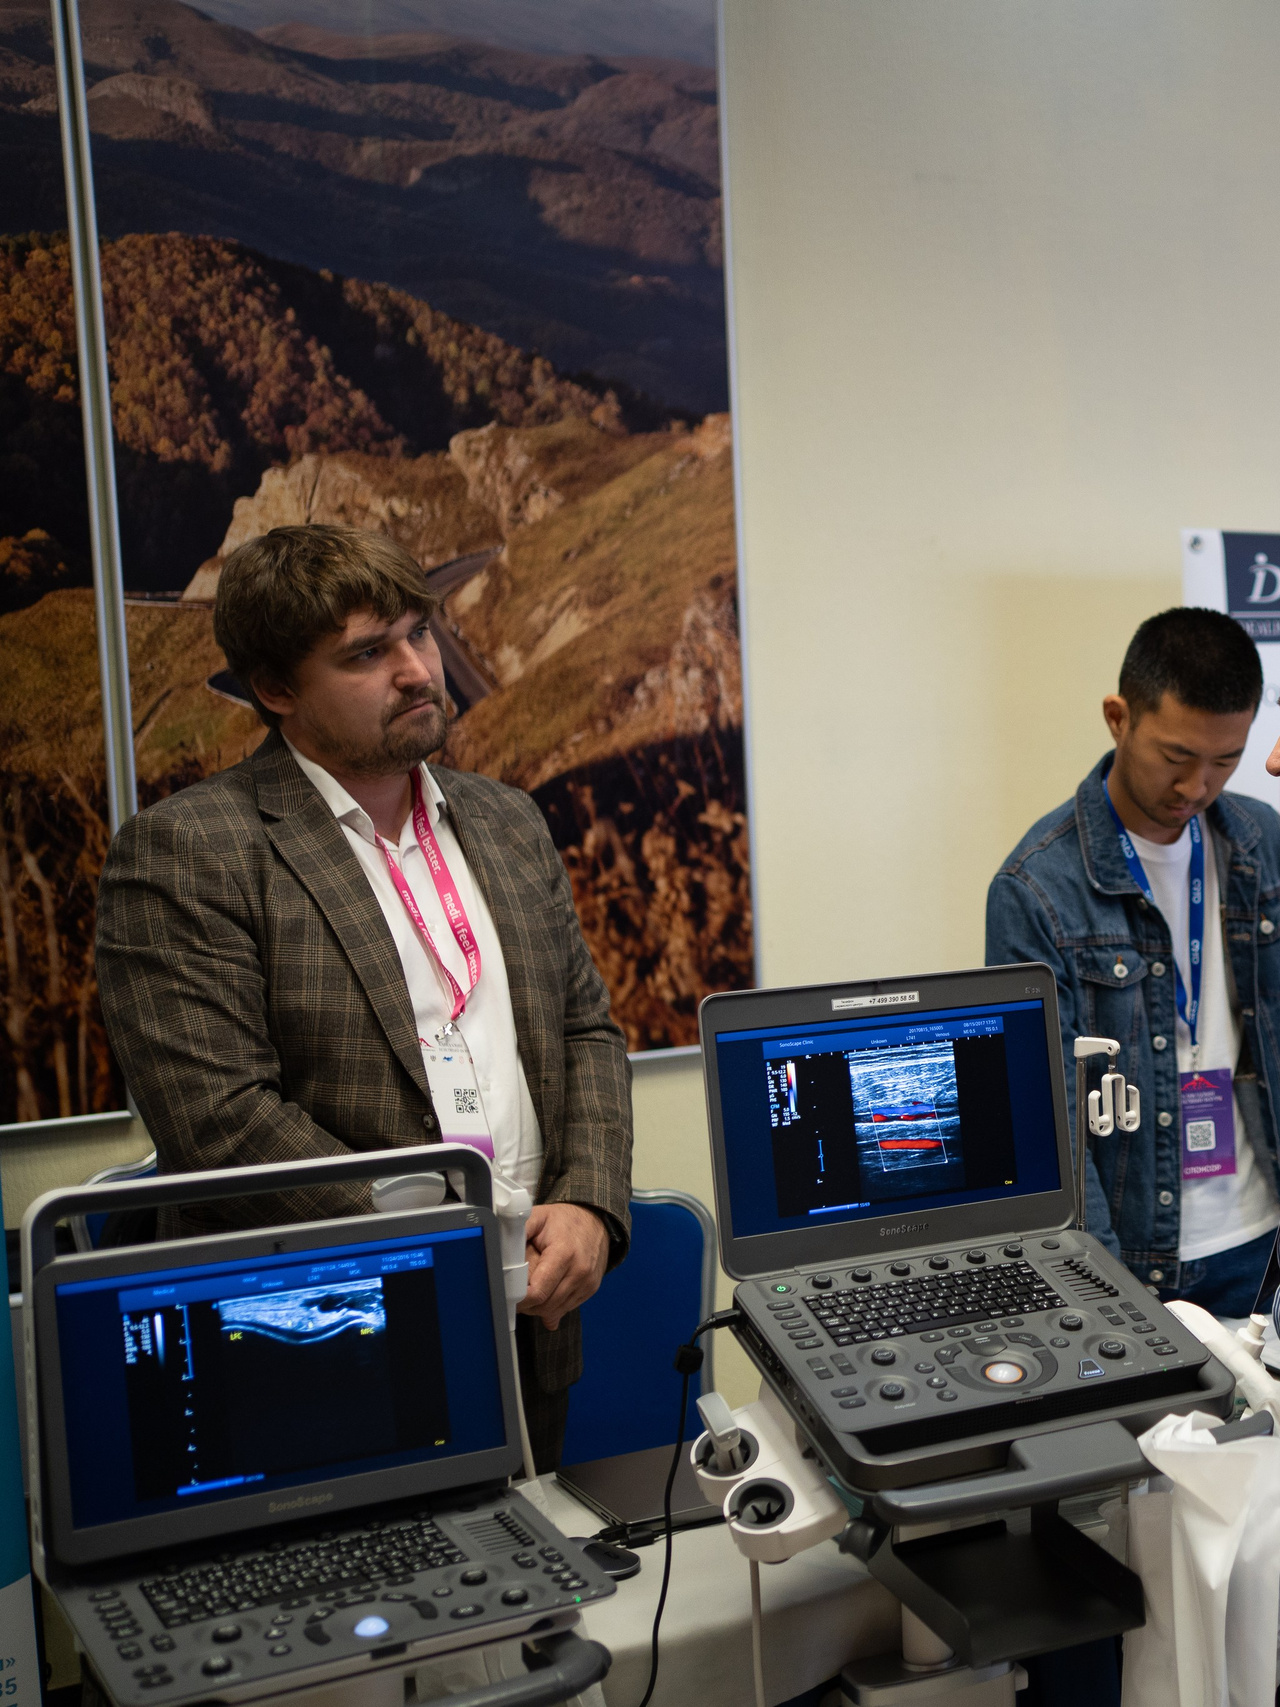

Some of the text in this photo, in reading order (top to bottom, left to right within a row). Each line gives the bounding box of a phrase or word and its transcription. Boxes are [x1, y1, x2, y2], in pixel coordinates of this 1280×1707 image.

[422, 836, 442, 875] better.
[402, 889, 418, 920] medi.
[442, 892, 462, 924] medi.
[457, 928, 475, 952] feel
[467, 951, 479, 985] bette
[879, 1222, 930, 1237] SonoScape
[268, 1492, 334, 1514] SonoScape
